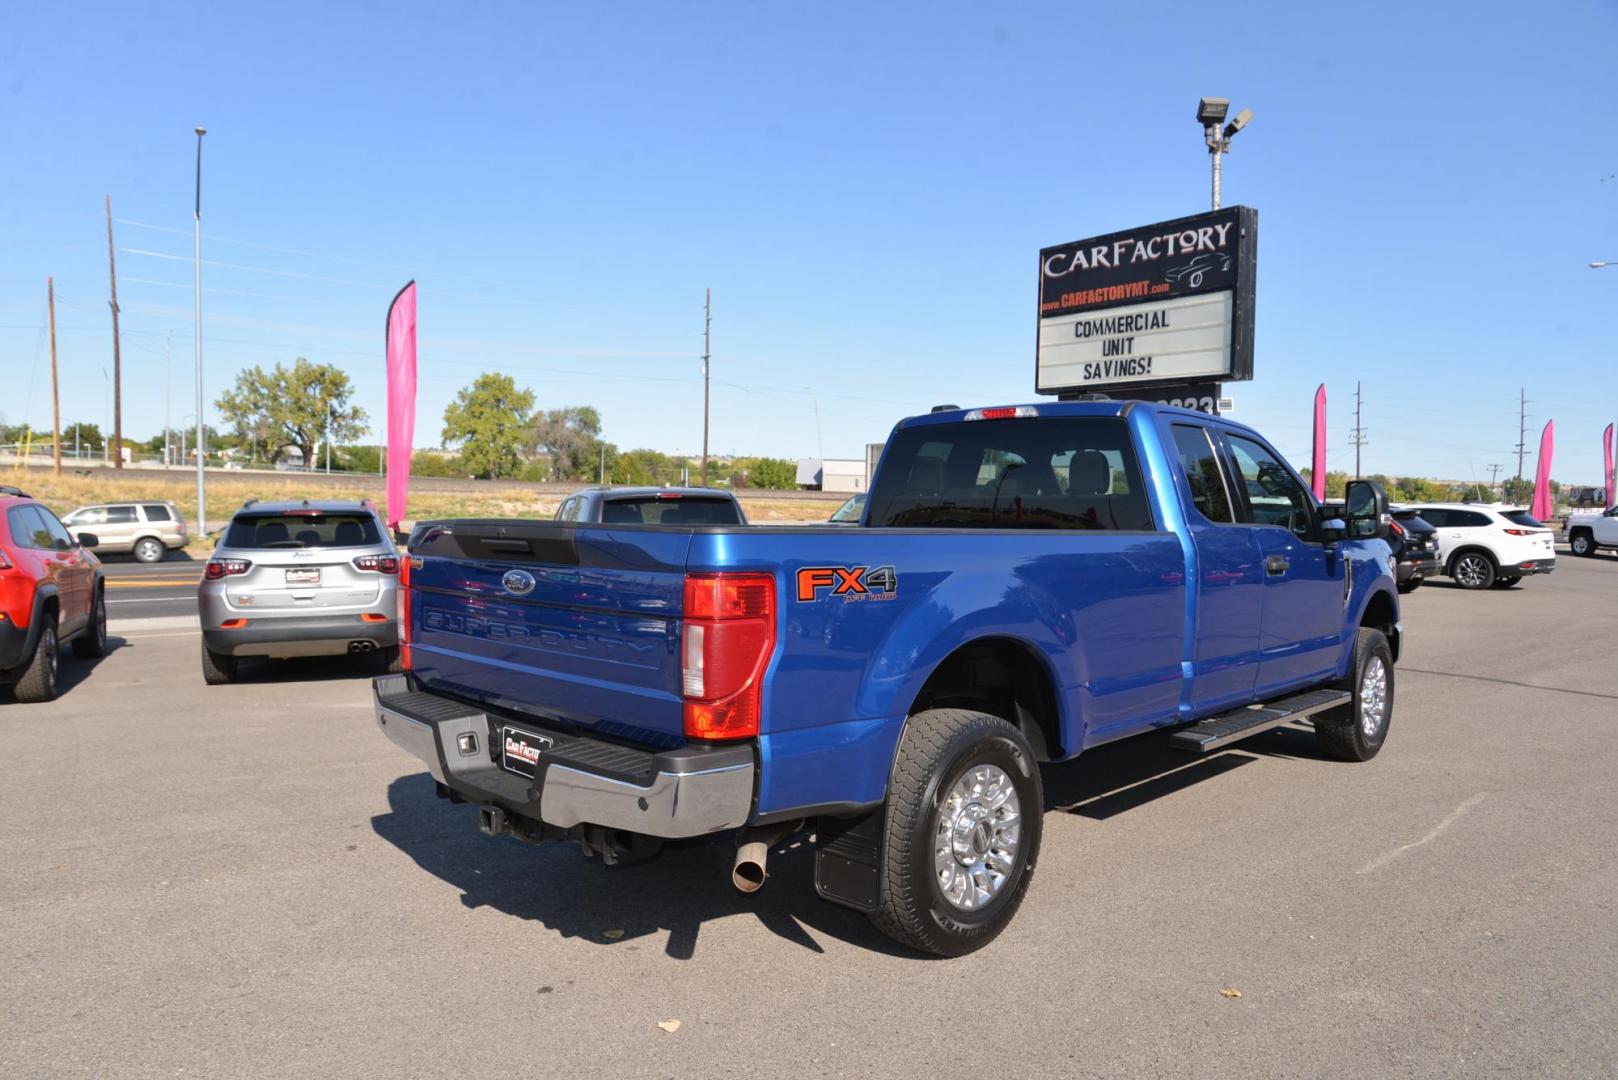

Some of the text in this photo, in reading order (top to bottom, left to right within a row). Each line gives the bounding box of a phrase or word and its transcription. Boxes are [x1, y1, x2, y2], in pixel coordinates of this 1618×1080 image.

[1075, 310, 1169, 338] COMMERCIAL
[1102, 337, 1134, 357] UNIT
[1083, 357, 1152, 380] SAVINGS!
[796, 565, 897, 603] FX4
[426, 611, 656, 661] SUPER DUTY
